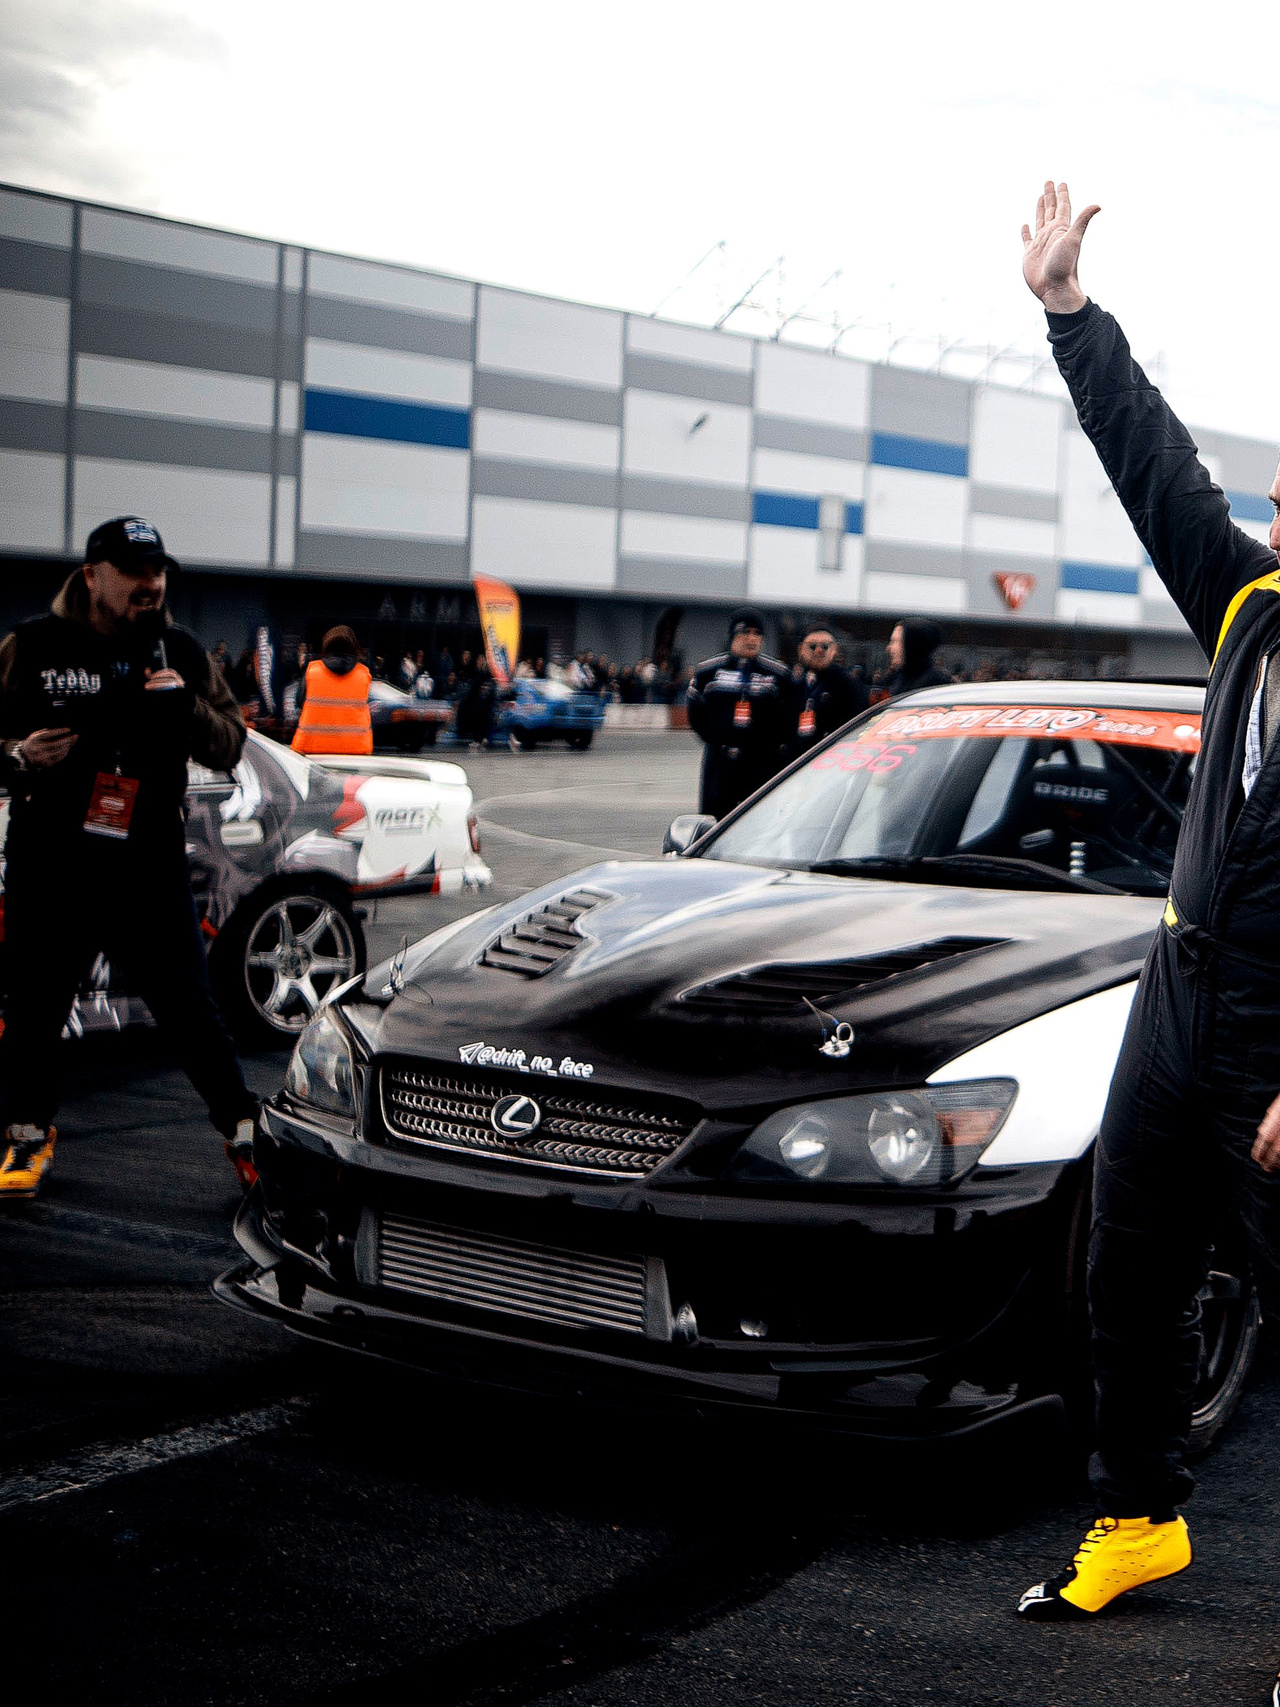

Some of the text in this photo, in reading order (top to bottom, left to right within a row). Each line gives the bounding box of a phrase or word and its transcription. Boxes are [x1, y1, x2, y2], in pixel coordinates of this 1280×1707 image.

[41, 668, 101, 694] Teddy
[811, 743, 918, 773] 666
[1033, 781, 1109, 801] BRIDE
[477, 1046, 594, 1078] @drift_no_face
